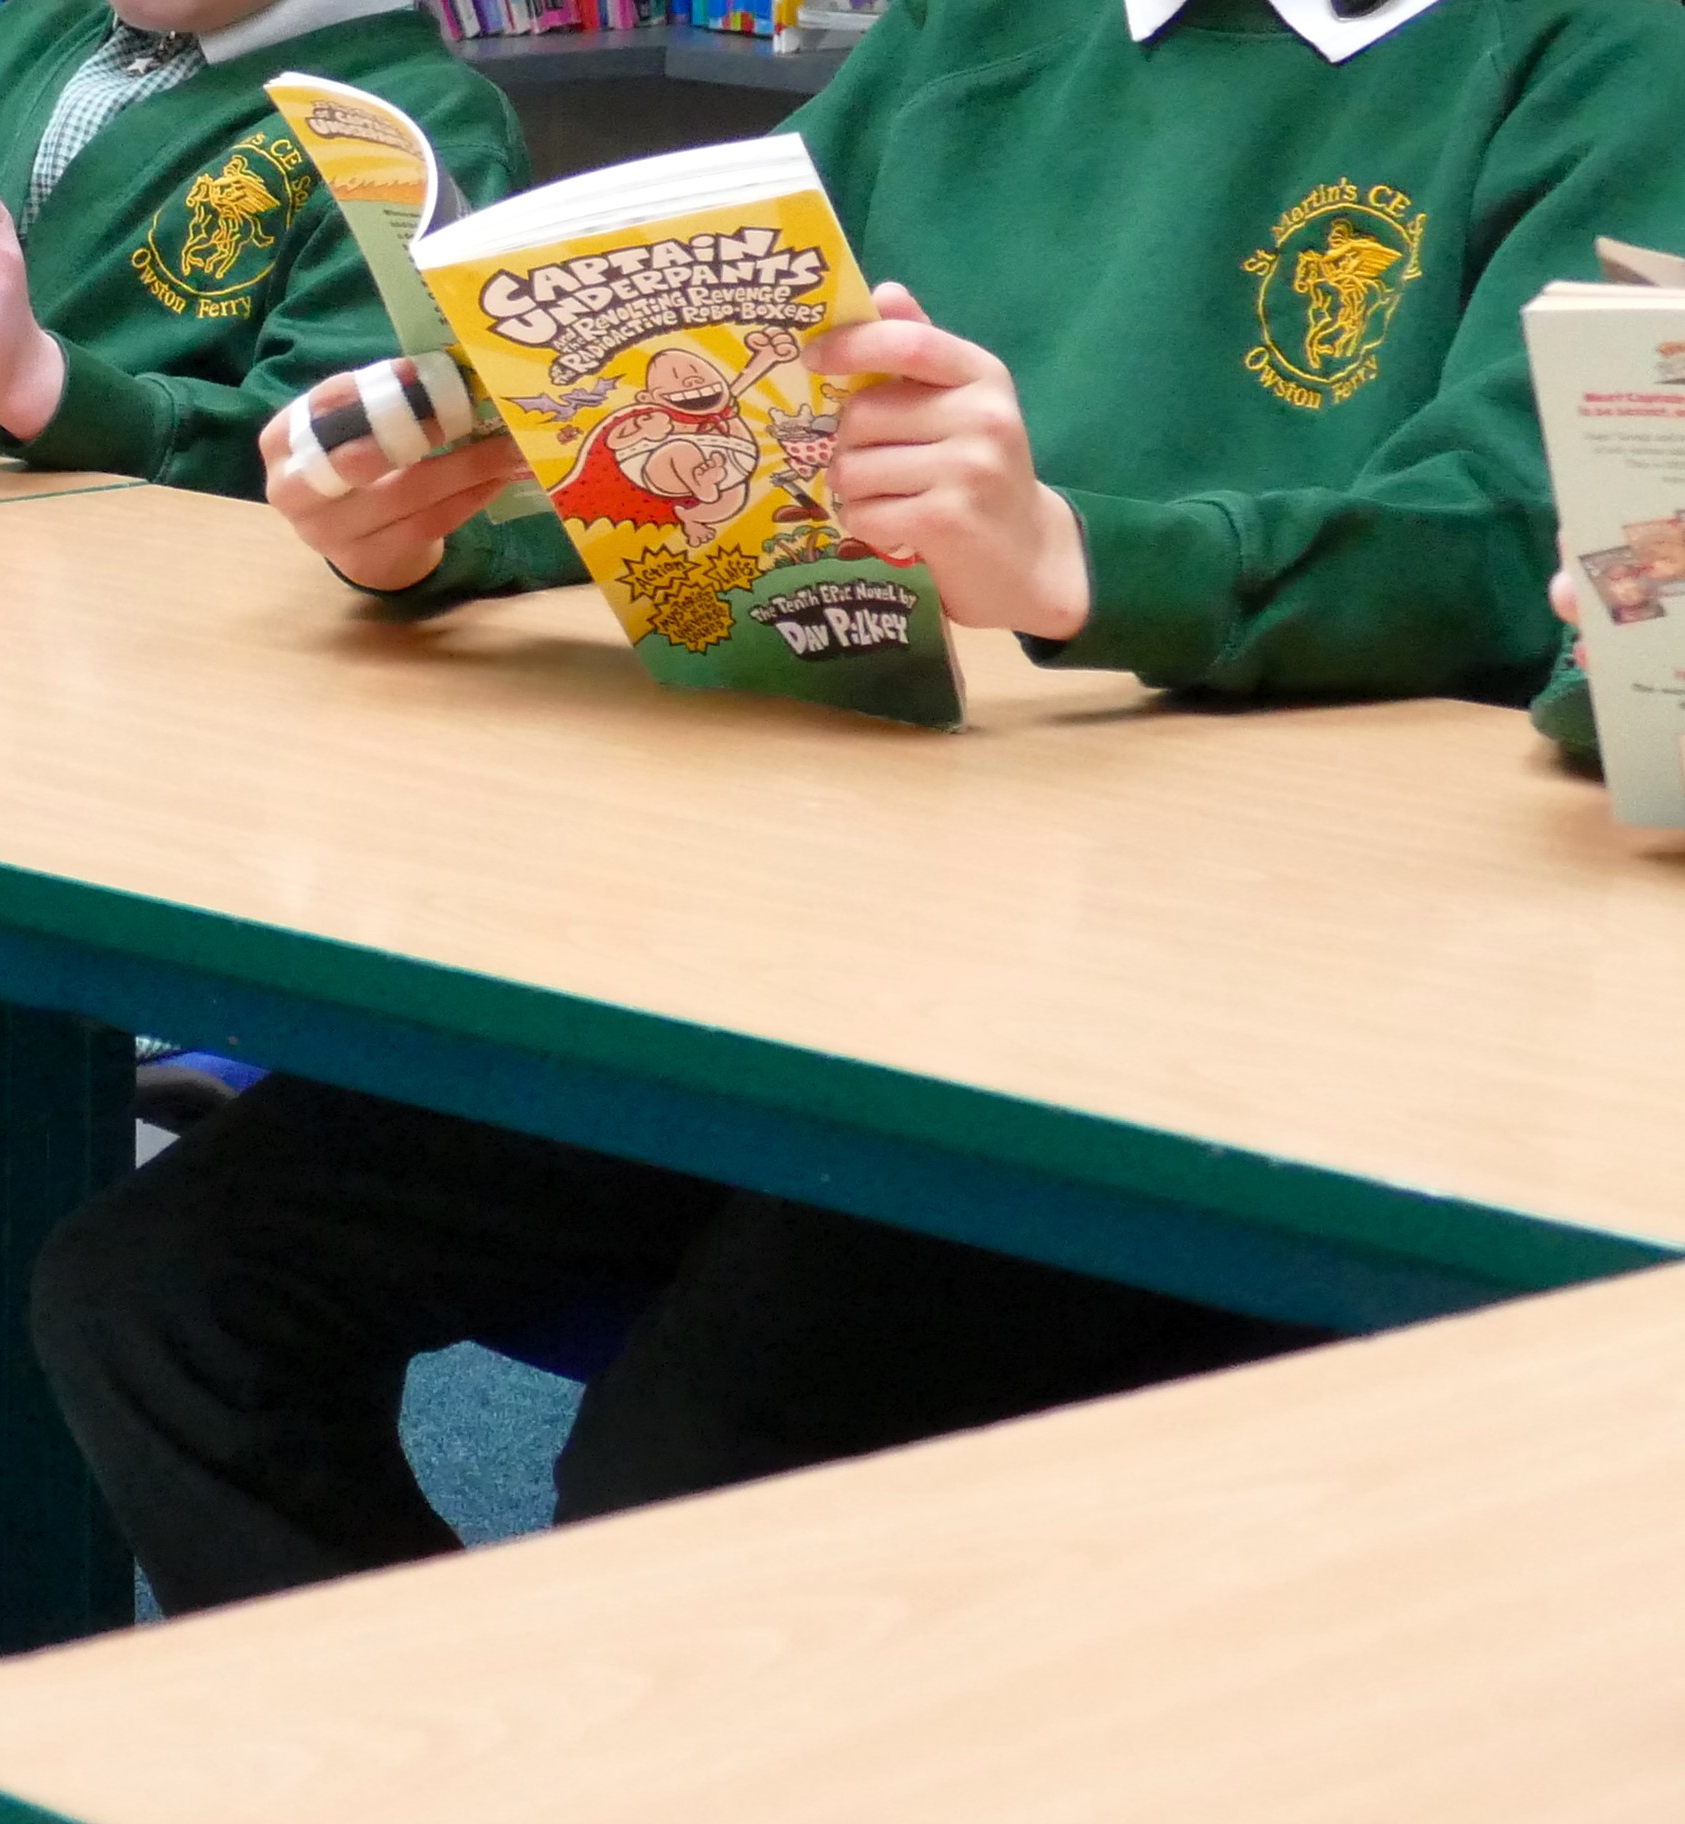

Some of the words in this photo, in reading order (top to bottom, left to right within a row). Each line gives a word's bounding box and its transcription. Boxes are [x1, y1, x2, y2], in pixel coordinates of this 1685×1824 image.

[271, 139, 302, 171] CE
[1369, 185, 1412, 218] CE
[132, 248, 186, 315] Owston
[197, 296, 252, 319] Ferry
[490, 248, 829, 346] UNDERPANTS
[1245, 346, 1323, 409] Owston
